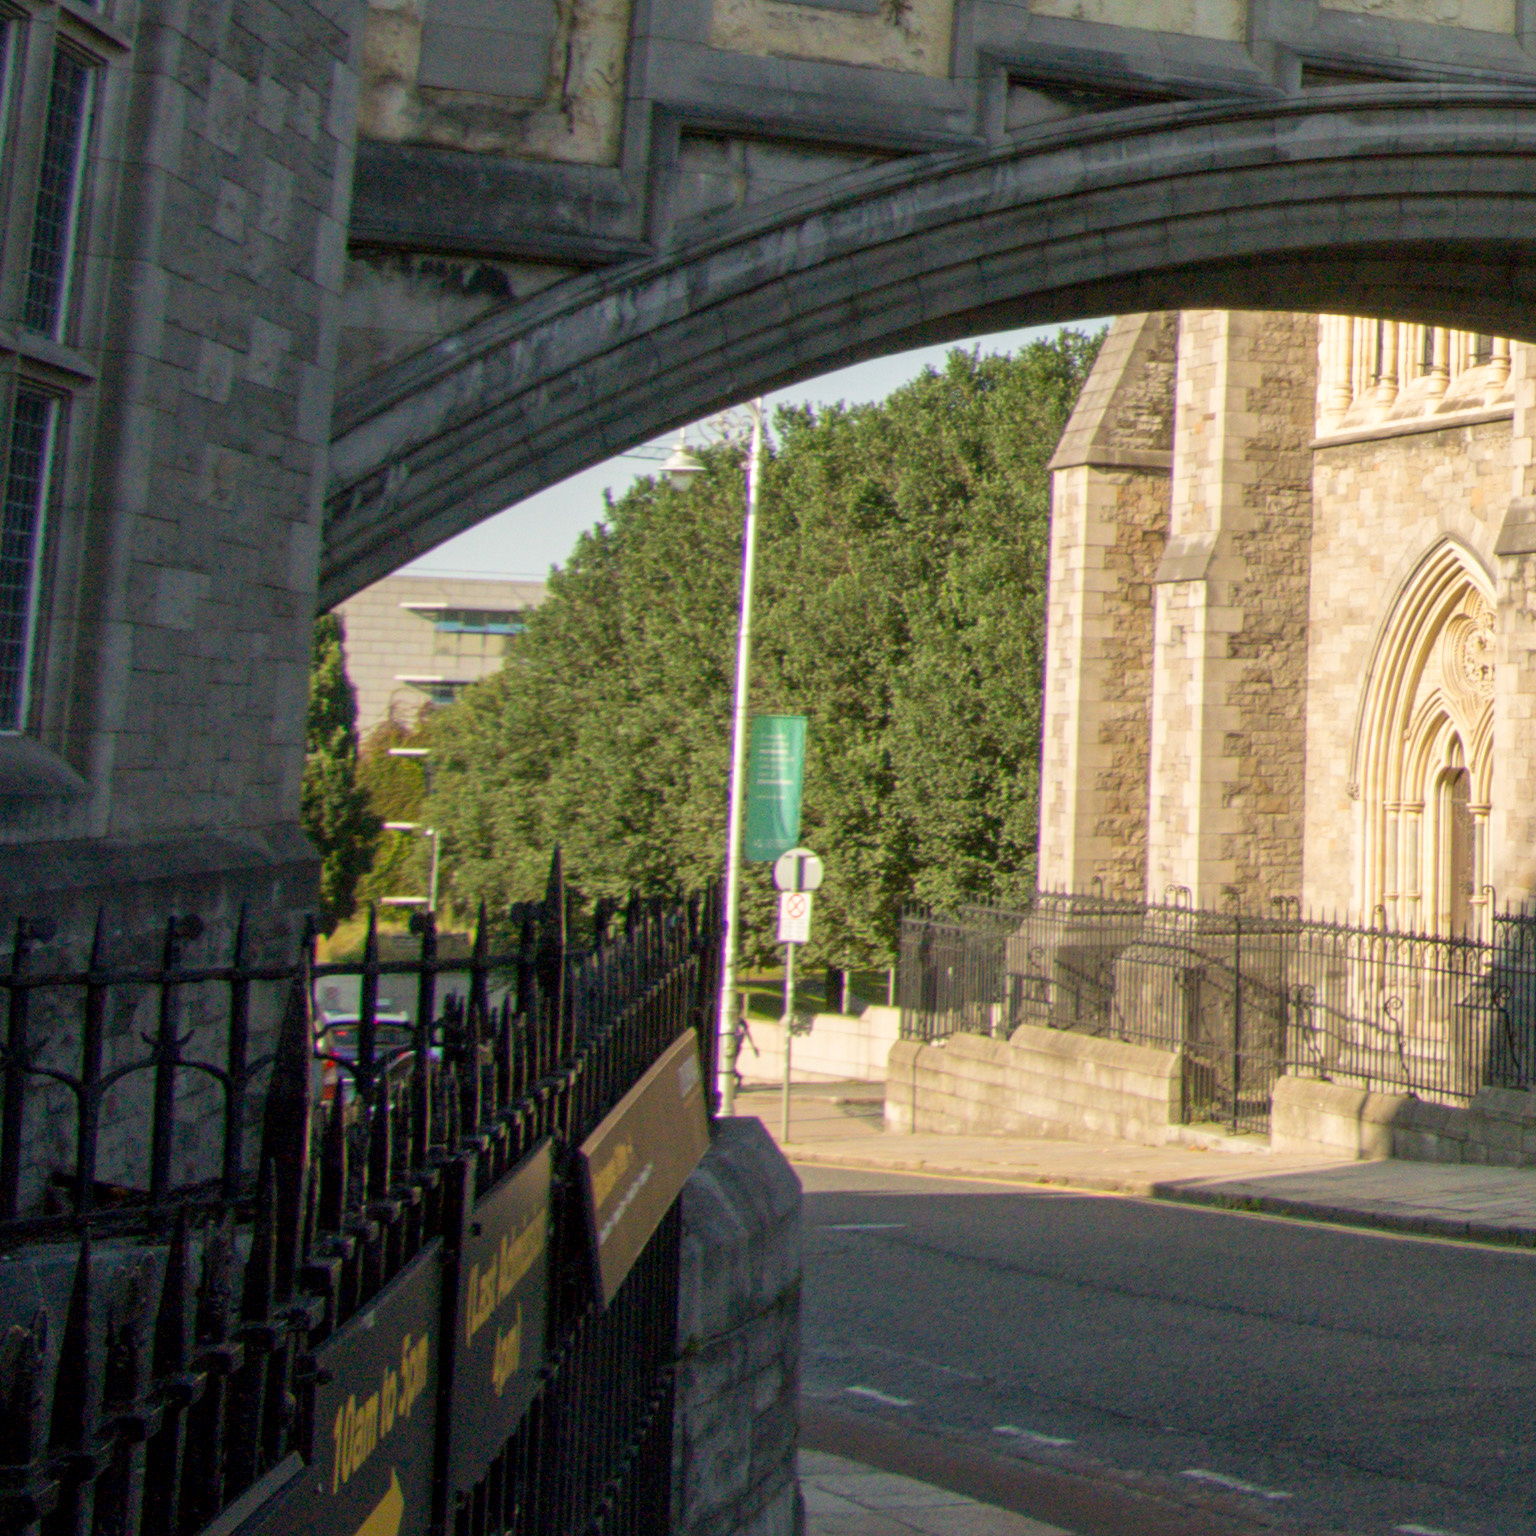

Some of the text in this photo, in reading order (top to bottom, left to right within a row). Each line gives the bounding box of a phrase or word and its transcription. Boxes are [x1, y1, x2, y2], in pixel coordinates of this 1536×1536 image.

[332, 1332, 429, 1495] 10am to 5pm
